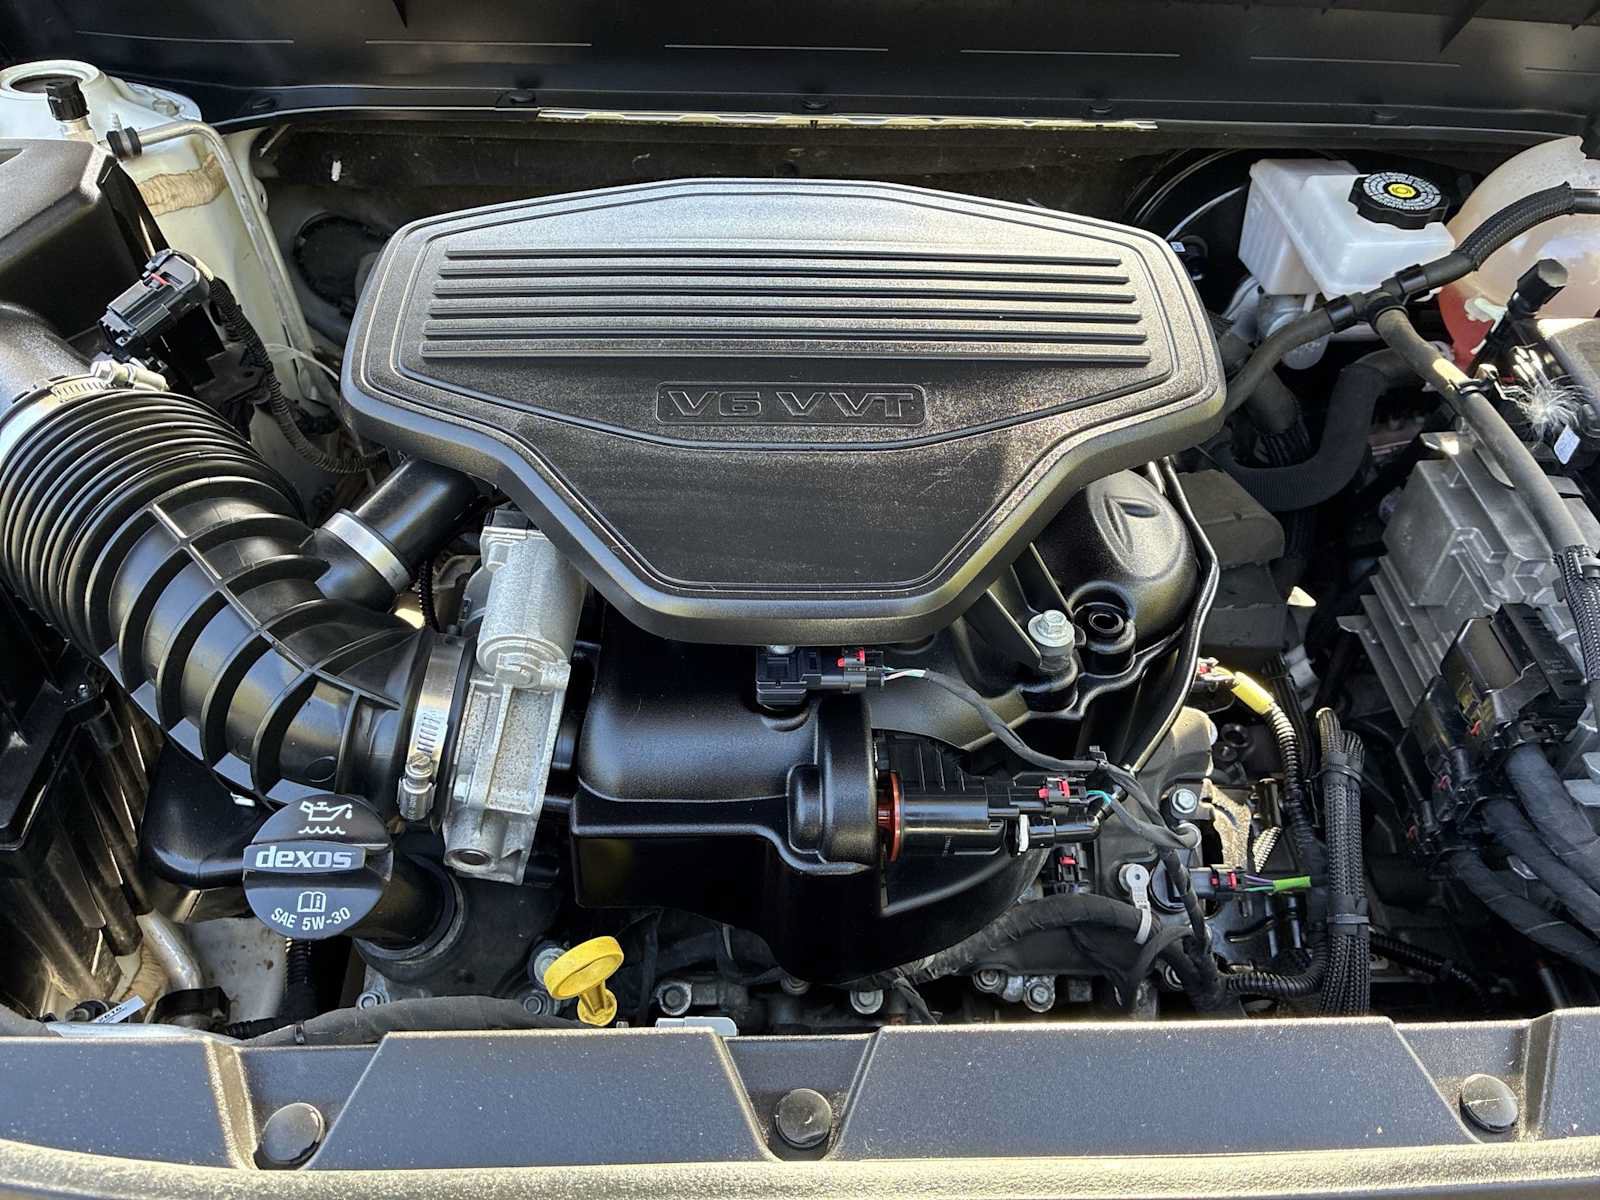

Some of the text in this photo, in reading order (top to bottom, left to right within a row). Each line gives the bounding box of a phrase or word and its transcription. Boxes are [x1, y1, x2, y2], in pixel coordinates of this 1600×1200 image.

[668, 391, 914, 417] V6 VVT
[255, 845, 353, 868] dexos
[271, 906, 351, 930] SAE 5W-30
